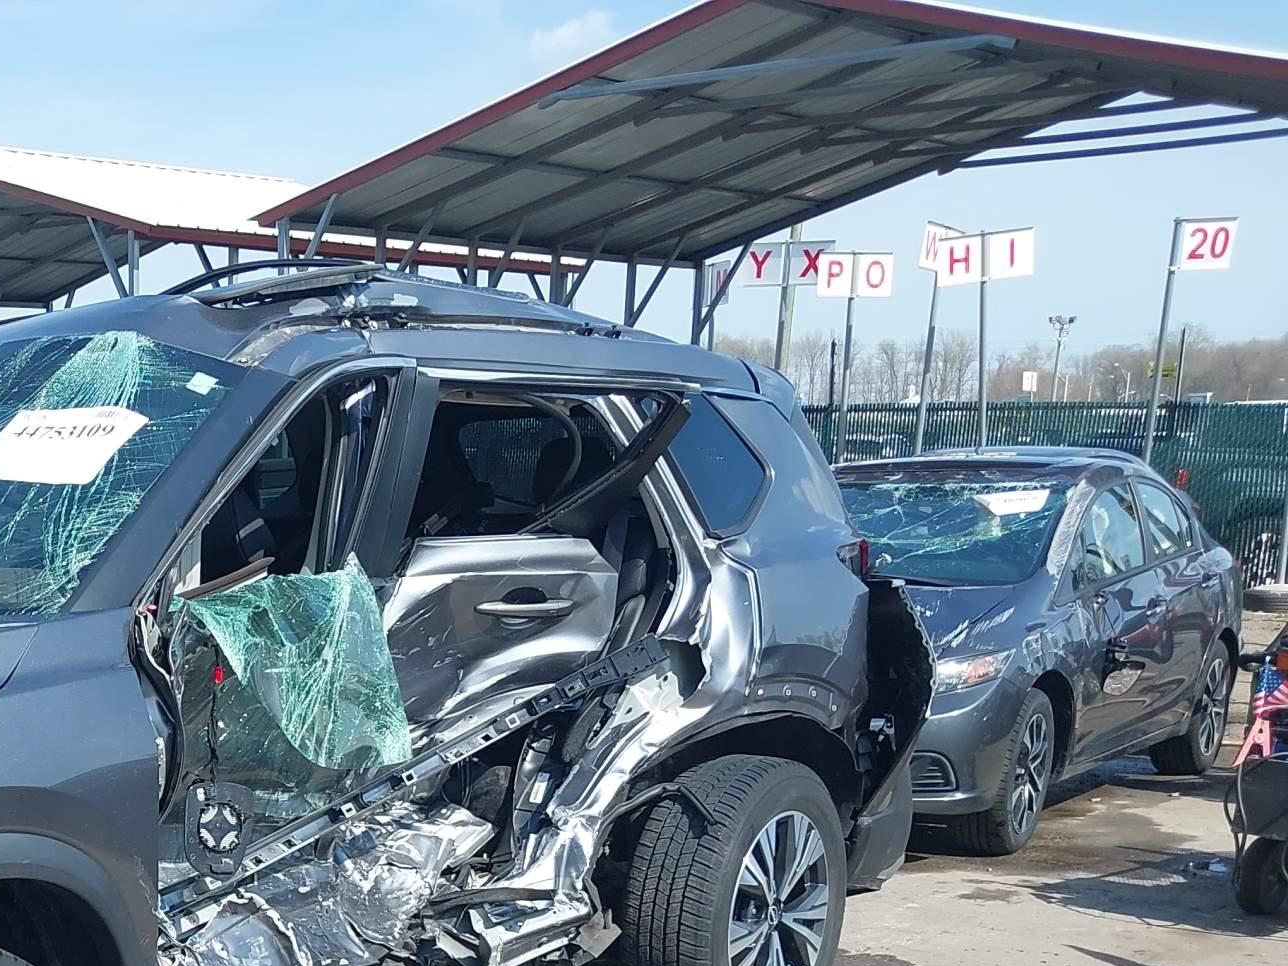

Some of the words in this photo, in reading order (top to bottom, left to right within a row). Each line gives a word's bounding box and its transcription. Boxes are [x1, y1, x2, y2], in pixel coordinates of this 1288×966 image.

[949, 243, 970, 275] H
[1008, 237, 1015, 268] I
[1185, 226, 1231, 261] 20
[749, 250, 773, 279] Y
[799, 248, 824, 278] X
[827, 260, 844, 289] P
[865, 260, 886, 289] O
[12, 423, 116, 440] 44753109
